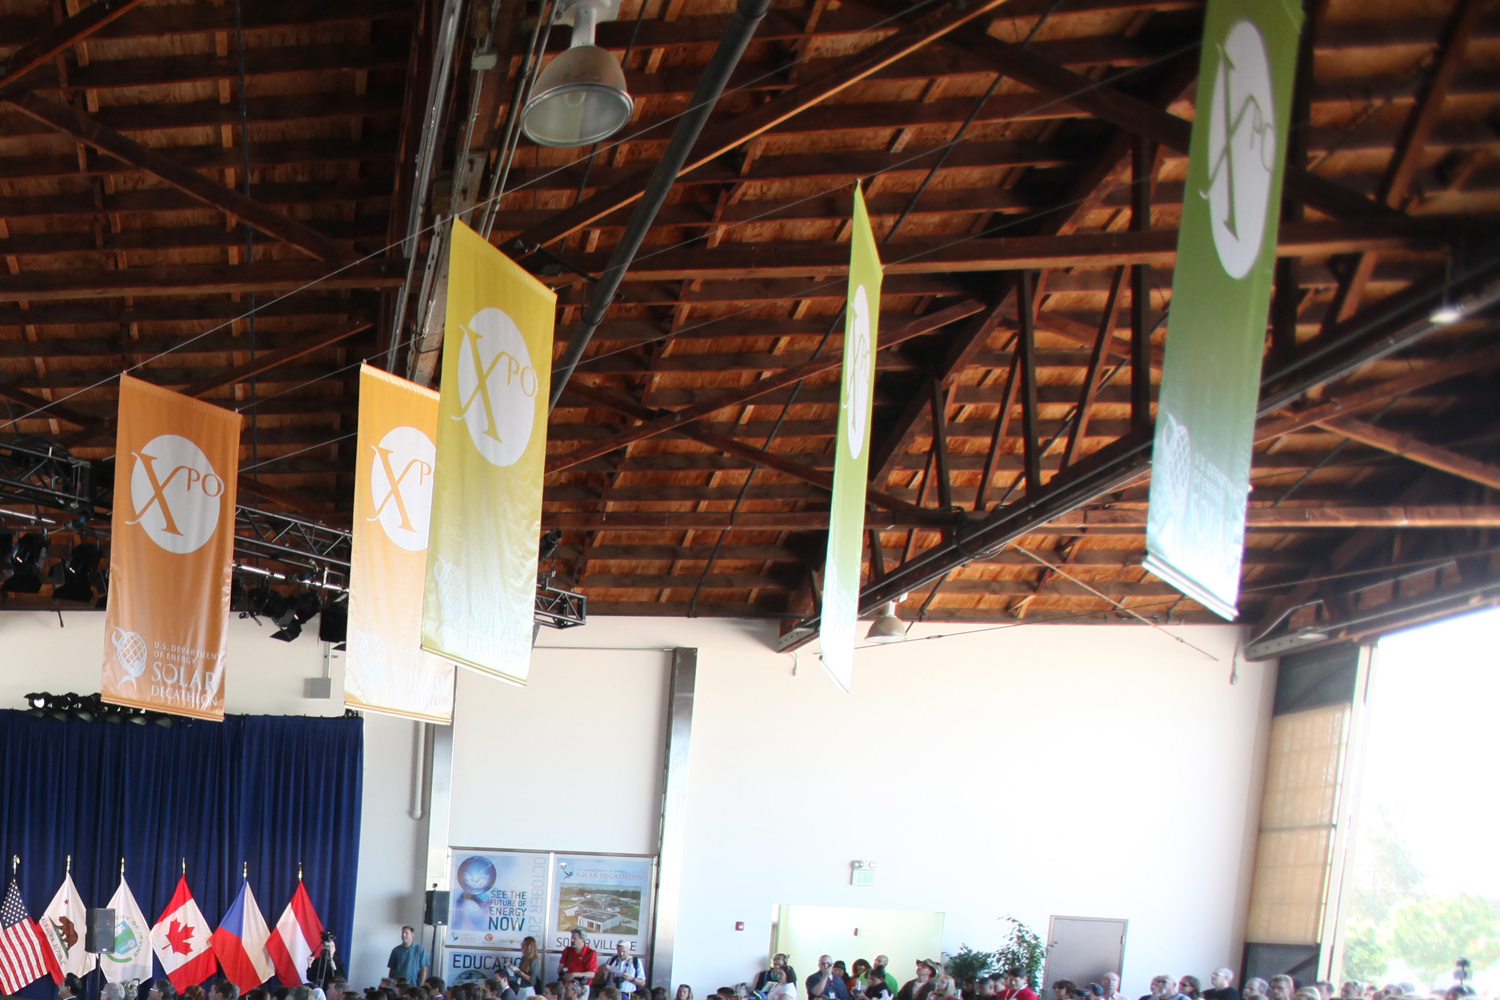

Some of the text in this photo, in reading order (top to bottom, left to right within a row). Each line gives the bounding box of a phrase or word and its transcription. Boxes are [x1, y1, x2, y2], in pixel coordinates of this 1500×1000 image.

[451, 323, 539, 444] XPO
[124, 451, 226, 537] XPO
[366, 444, 433, 534] XP
[153, 650, 197, 665] OF ENERGY
[154, 641, 221, 660] U.S. DEPARTMENT
[151, 661, 217, 692] SOLAR
[151, 684, 218, 707] DECATHLON
[529, 856, 546, 913] OCTOBER
[490, 889, 527, 899] SEE THE
[489, 899, 516, 907] FUTURE
[489, 907, 527, 916] ENERGY
[488, 916, 526, 931] NOW
[556, 937, 637, 951] SOR VILLE
[453, 954, 522, 970] EDUCATIO
